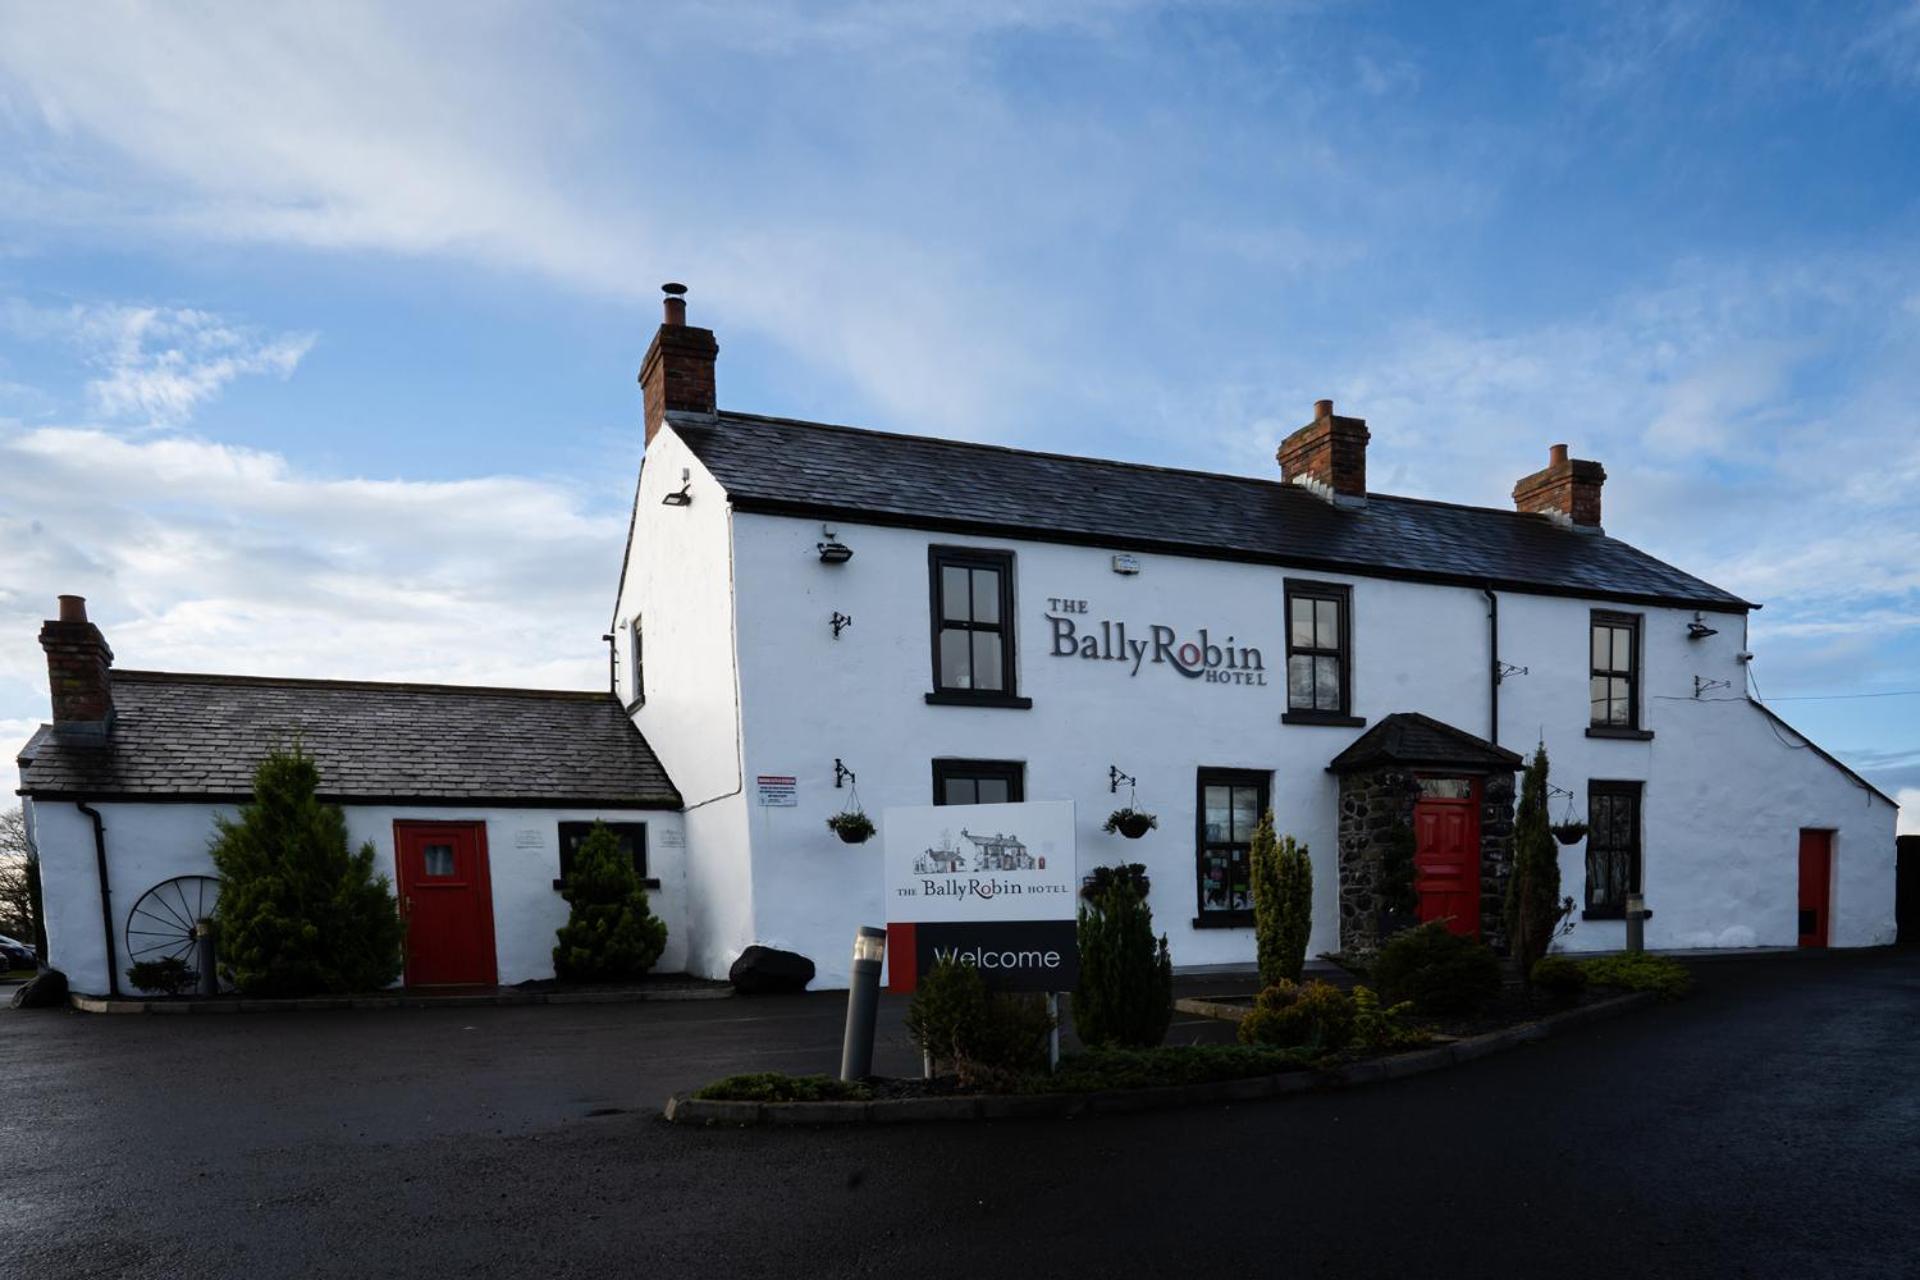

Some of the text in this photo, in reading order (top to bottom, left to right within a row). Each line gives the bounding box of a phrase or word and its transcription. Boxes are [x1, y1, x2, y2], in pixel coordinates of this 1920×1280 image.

[1047, 598, 1089, 614] THE
[1044, 613, 1265, 679] BallyRobin
[1205, 670, 1267, 686] HOTEL
[896, 879, 1069, 901] THE BallyRobin HOTEL
[934, 946, 1061, 969] Welcome
